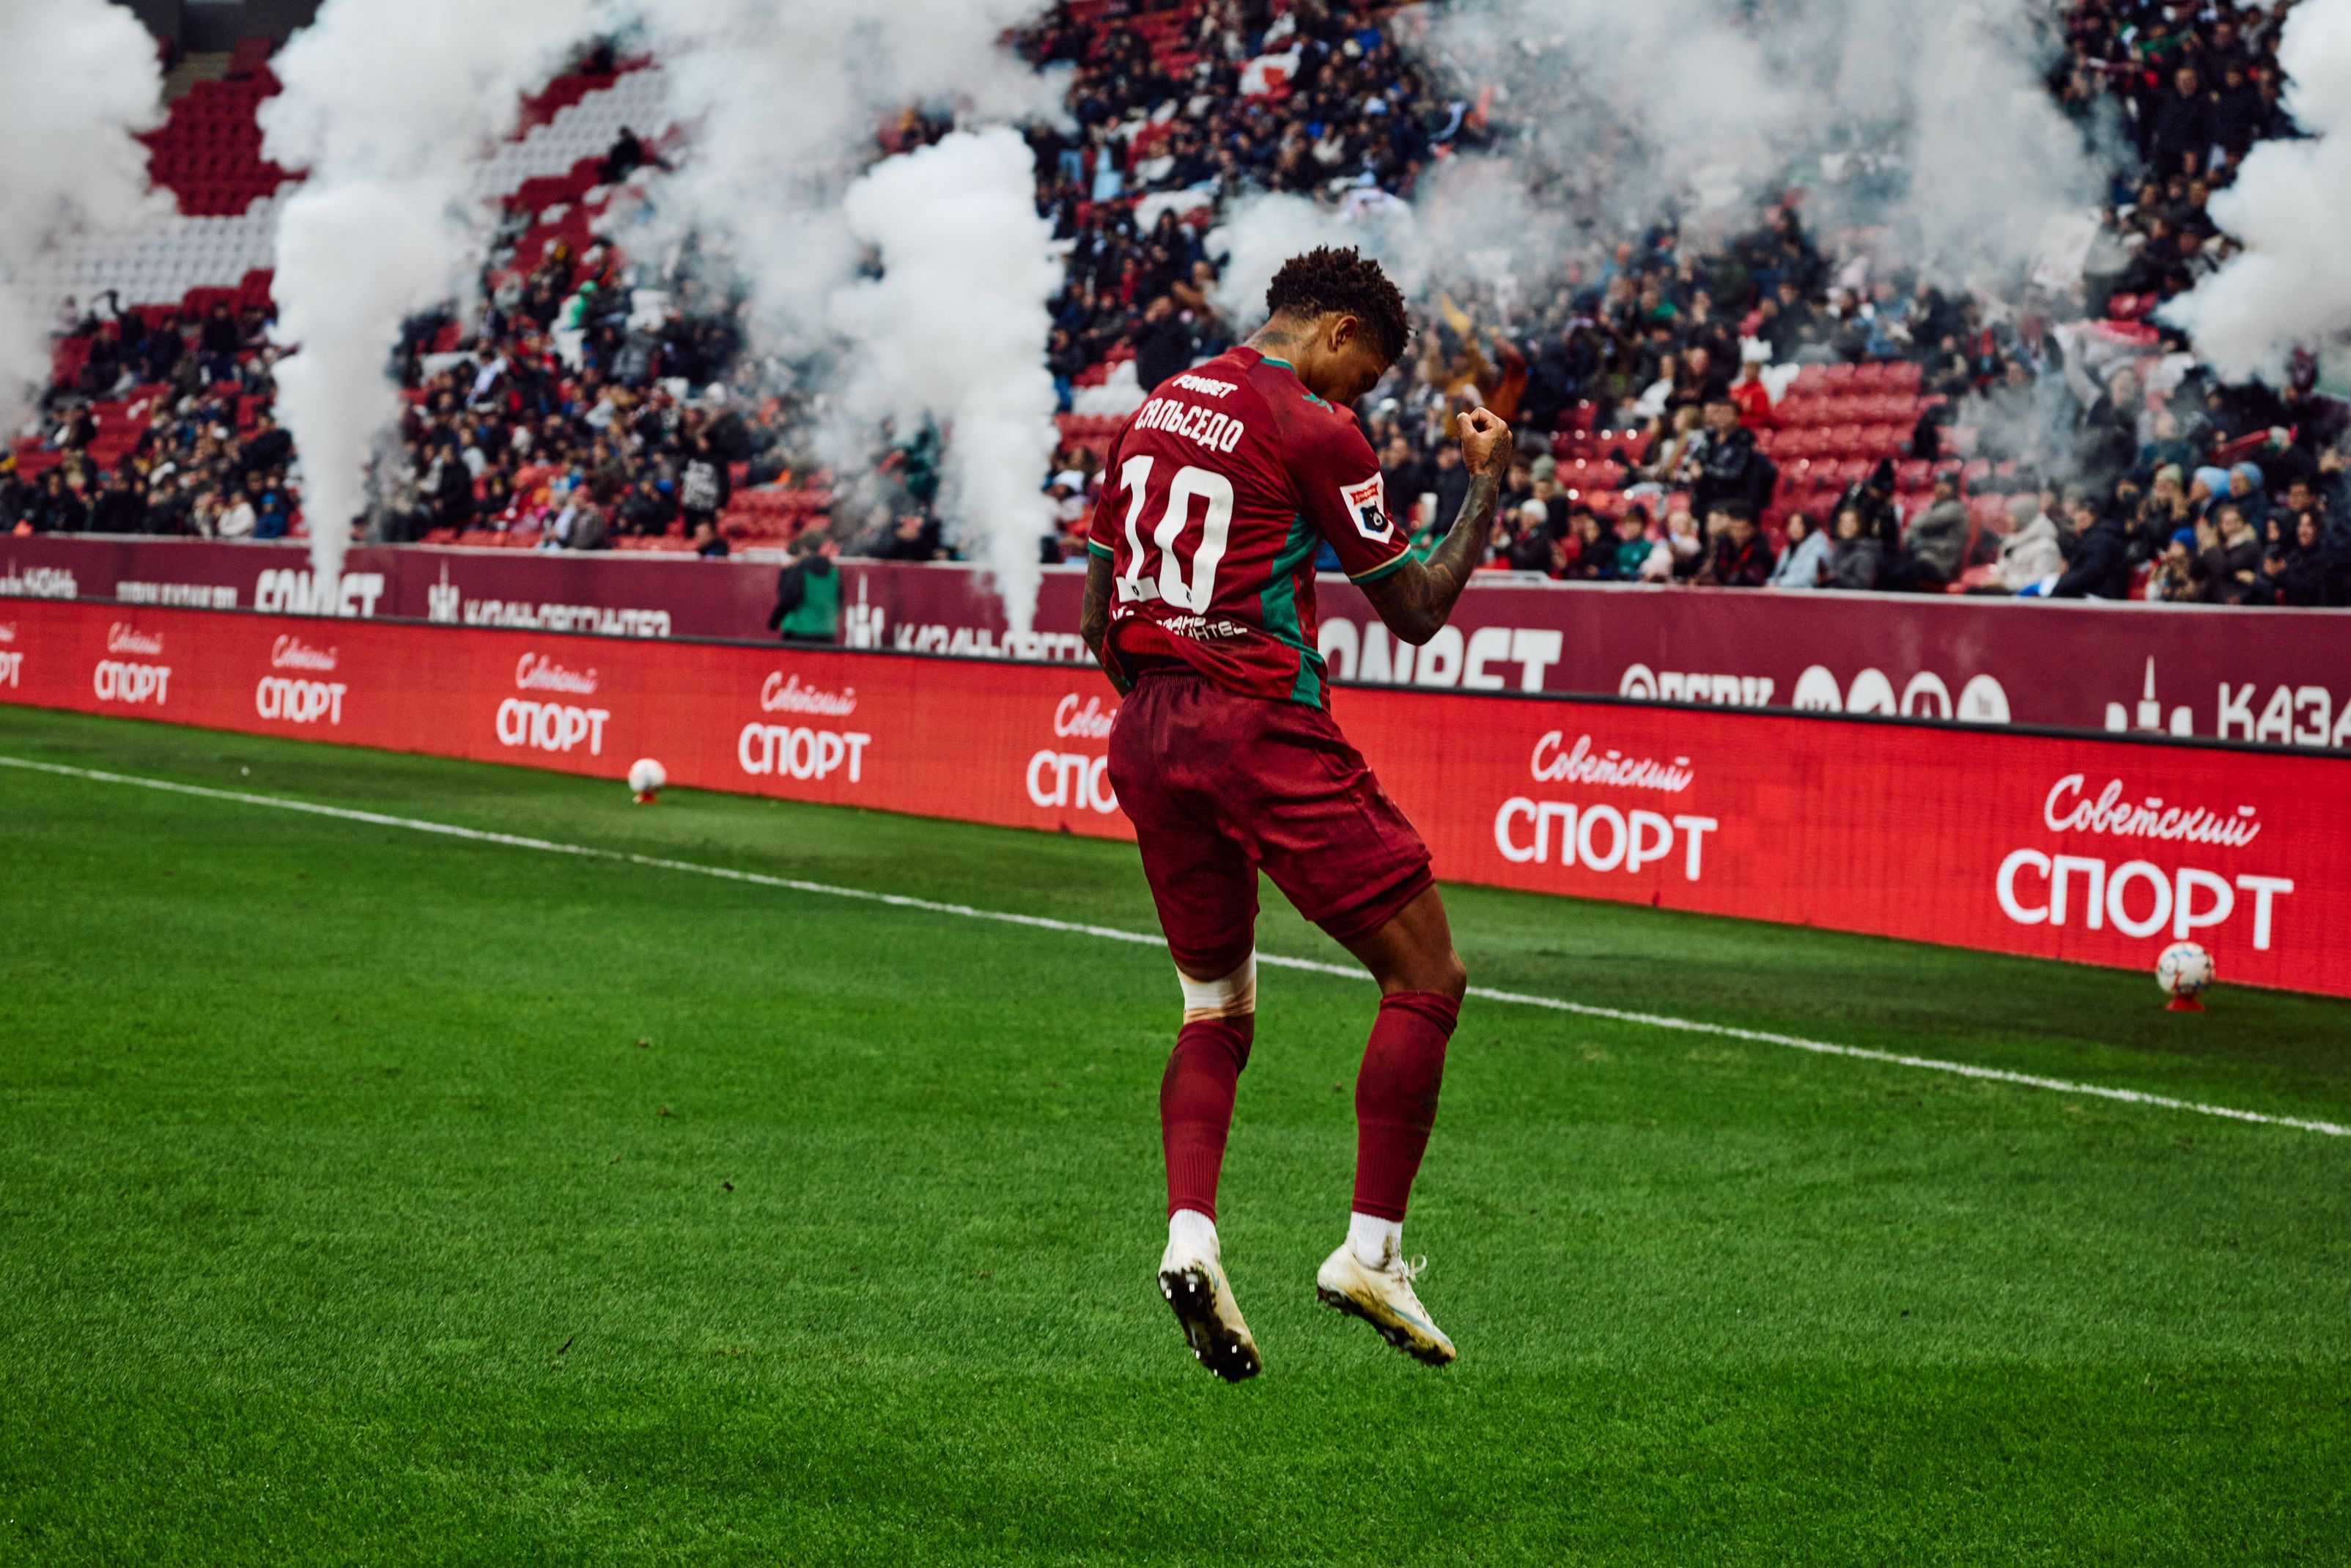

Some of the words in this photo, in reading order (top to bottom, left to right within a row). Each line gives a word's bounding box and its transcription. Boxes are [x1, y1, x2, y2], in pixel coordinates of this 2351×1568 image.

[1134, 397, 1244, 453] САЛЬСЕДО
[1115, 454, 1234, 615] 10
[94, 659, 171, 704] СПОРТ
[1318, 617, 1563, 692] ONBET
[256, 676, 347, 725] СПОРТ
[495, 697, 610, 756] СПОРТ
[737, 722, 871, 783] СПОРТ
[1025, 749, 1118, 814] СПО
[1531, 731, 1694, 793] Советский
[1494, 796, 1719, 881] СПОРТ
[2044, 774, 2261, 846] Советский
[1996, 848, 2295, 950] СПОРТ
